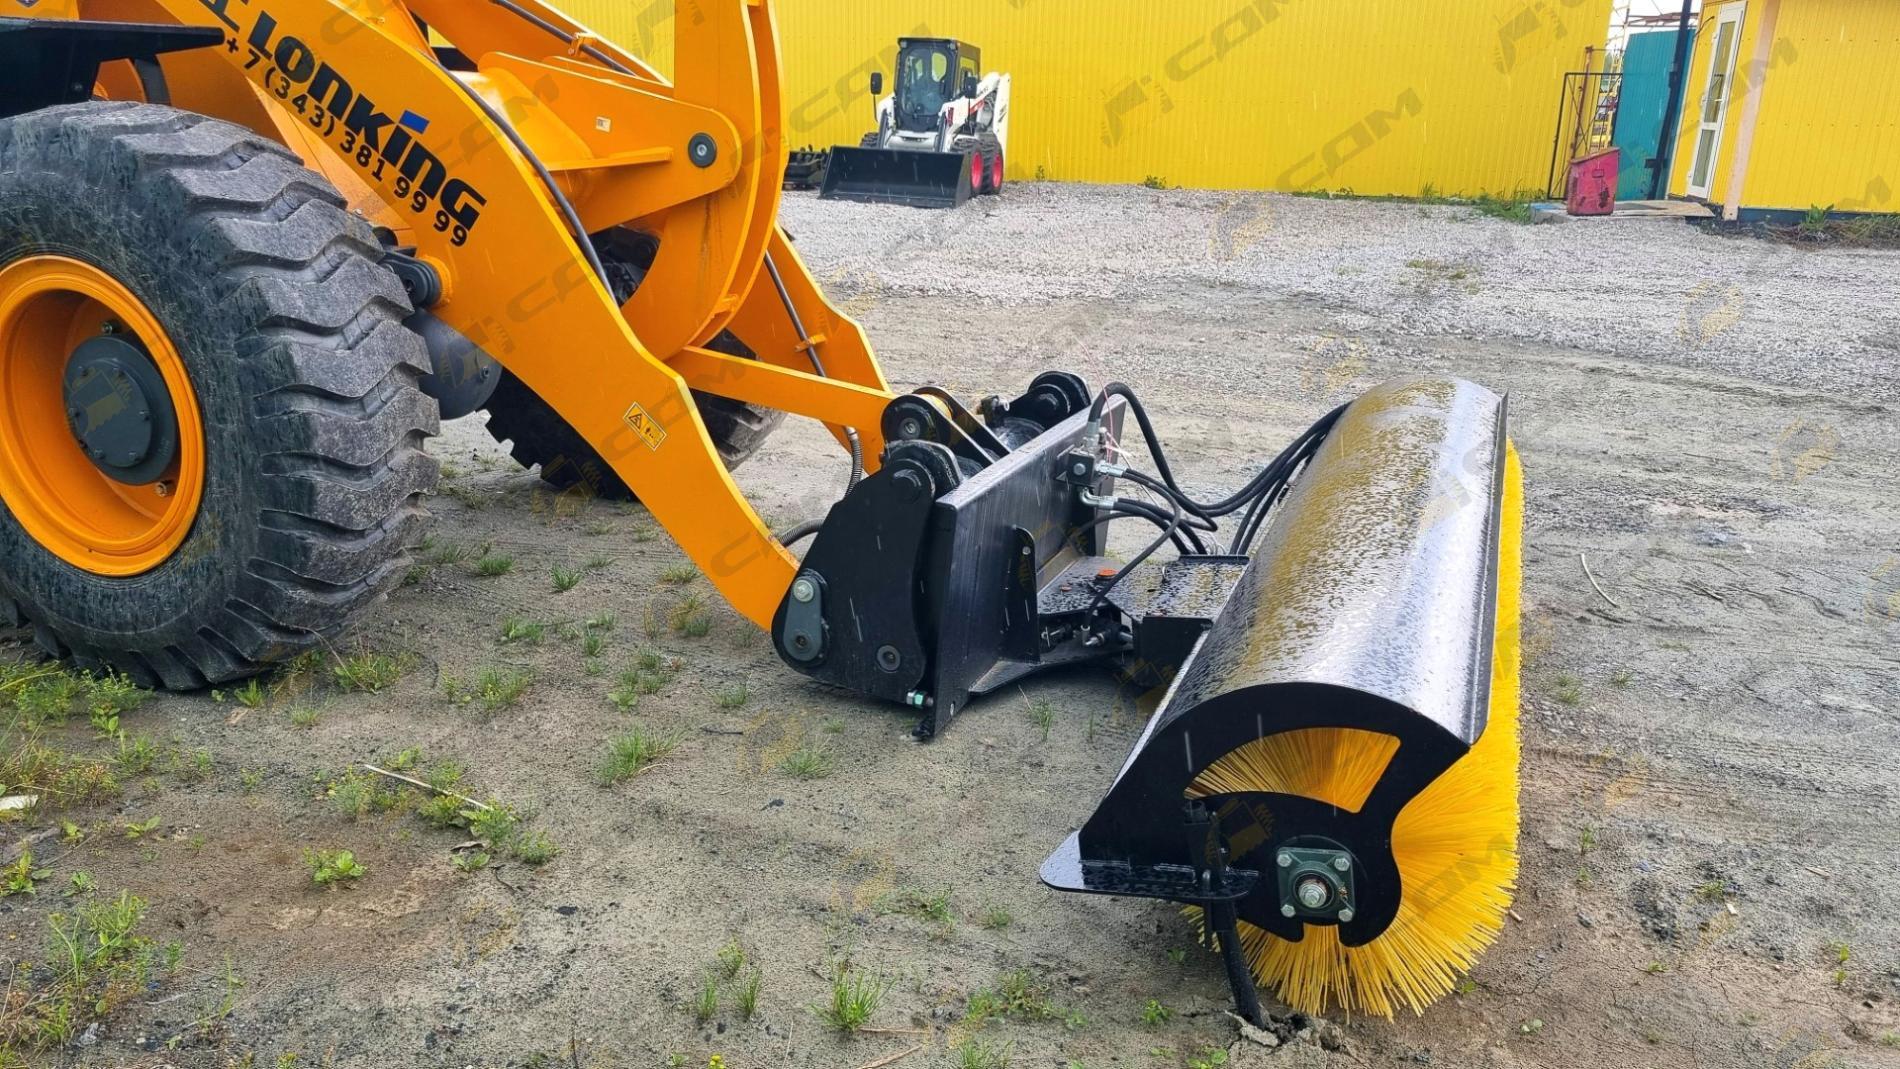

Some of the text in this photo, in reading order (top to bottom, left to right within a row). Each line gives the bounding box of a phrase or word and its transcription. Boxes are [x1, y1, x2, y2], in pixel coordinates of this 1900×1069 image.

[265, 66, 336, 137] (343)
[340, 130, 384, 182] 381
[393, 176, 428, 214] 99
[433, 209, 468, 247] 99
